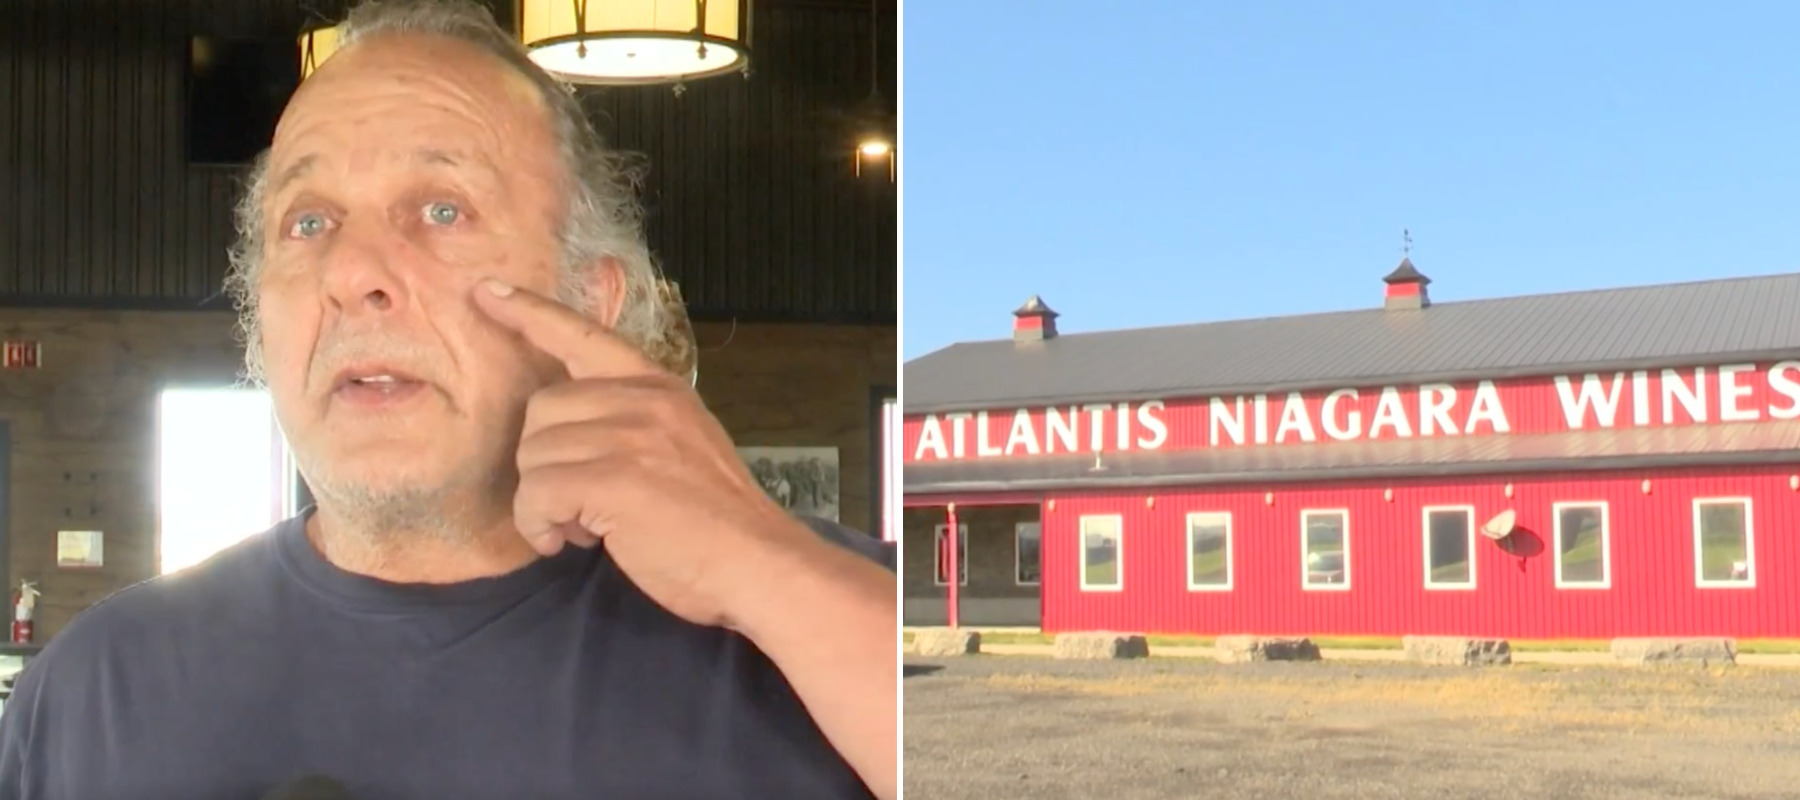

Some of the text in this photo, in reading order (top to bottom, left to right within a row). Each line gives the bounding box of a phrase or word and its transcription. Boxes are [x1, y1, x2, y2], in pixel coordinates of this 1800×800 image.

[914, 360, 1800, 460] ATLANTIS NIAGARA WINES
